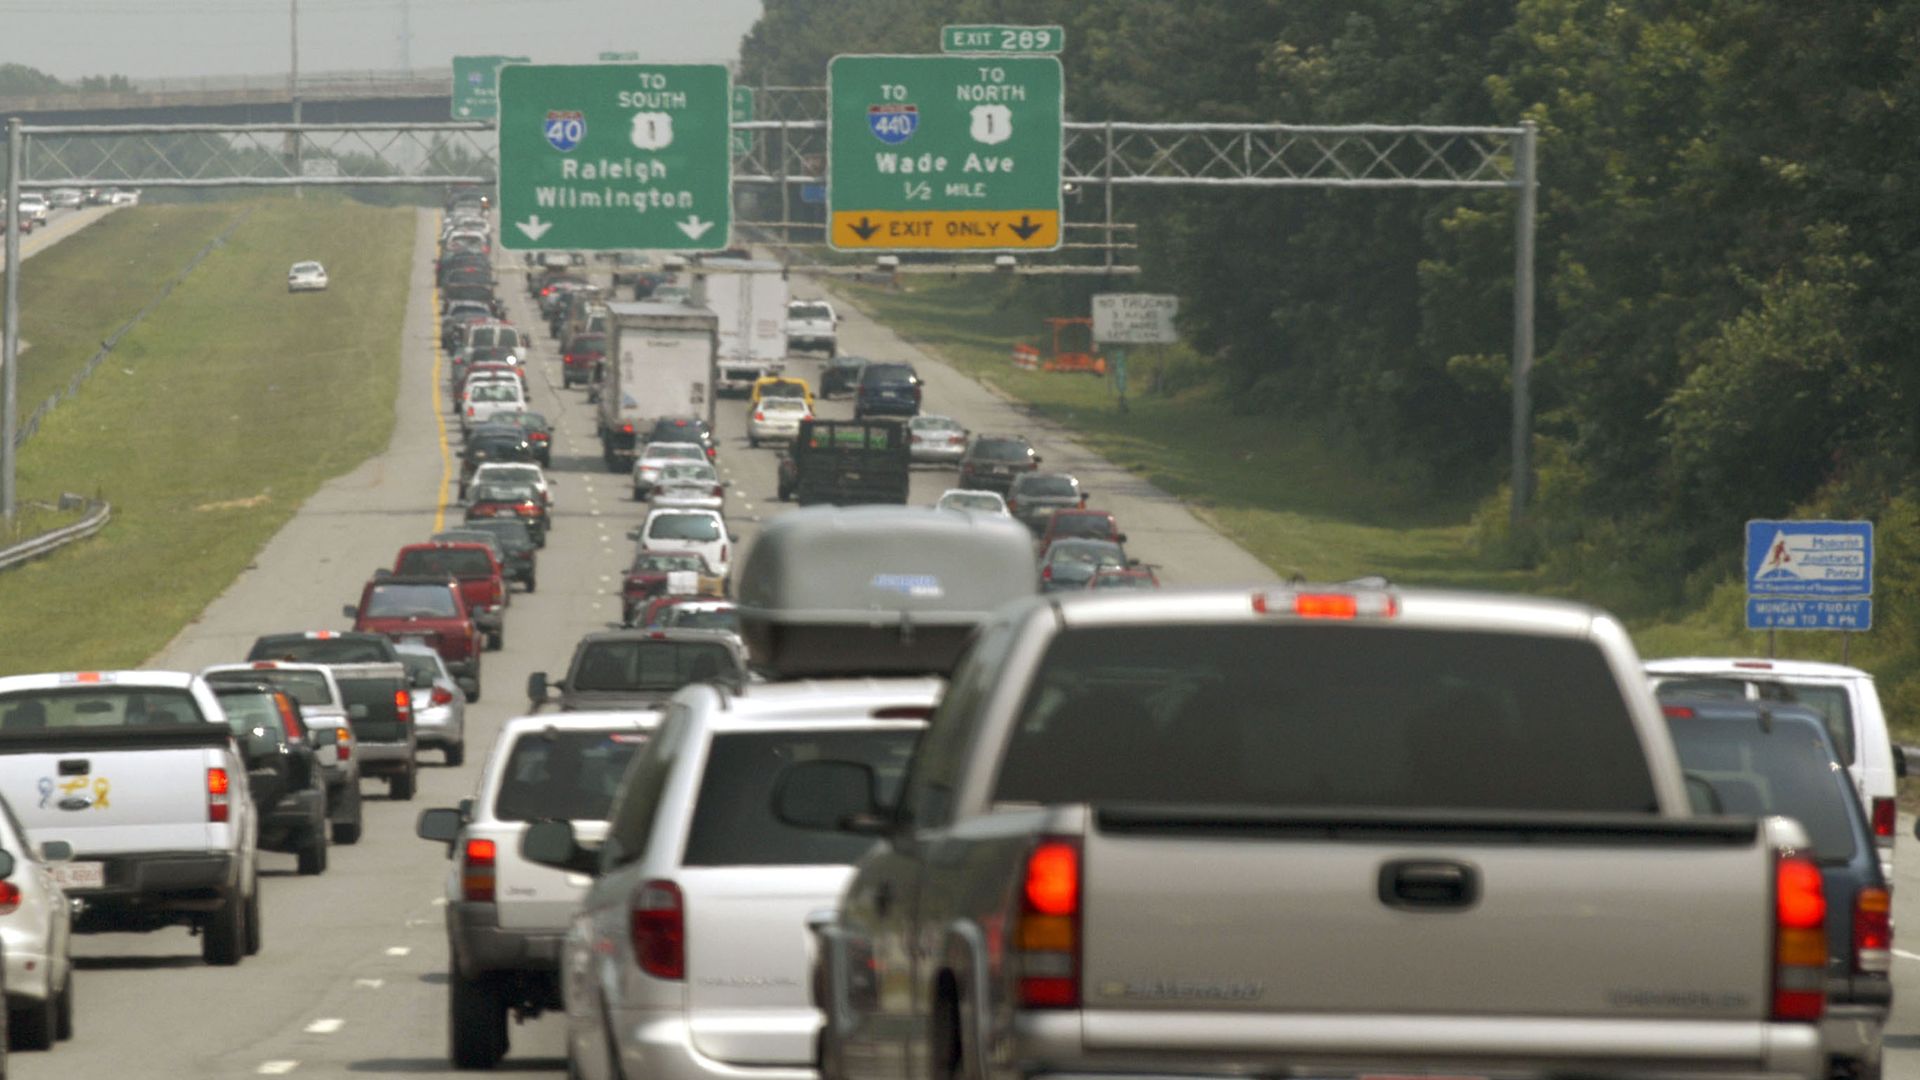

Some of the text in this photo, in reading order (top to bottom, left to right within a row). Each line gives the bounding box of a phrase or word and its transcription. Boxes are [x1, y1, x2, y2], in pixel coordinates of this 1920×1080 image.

[954, 31, 1051, 50] EXIT 289
[639, 73, 666, 89] TO
[978, 67, 1005, 83] TO
[618, 91, 686, 109] SOUTH
[880, 85, 907, 100] TO
[956, 85, 1025, 100] NORTH
[549, 120, 582, 143] 40
[649, 120, 656, 141] 1
[875, 116, 911, 135] 440
[986, 113, 994, 134] 1
[562, 159, 667, 184] Raleigh
[875, 153, 1015, 173] Wade Ave
[945, 183, 987, 197] MILE
[535, 186, 694, 213] Wilmington
[889, 221, 1000, 237] EXIT ONLY
[1755, 602, 1806, 613] MONDAY
[1817, 602, 1860, 613] FRIDAY
[1802, 614, 1818, 625] TO
